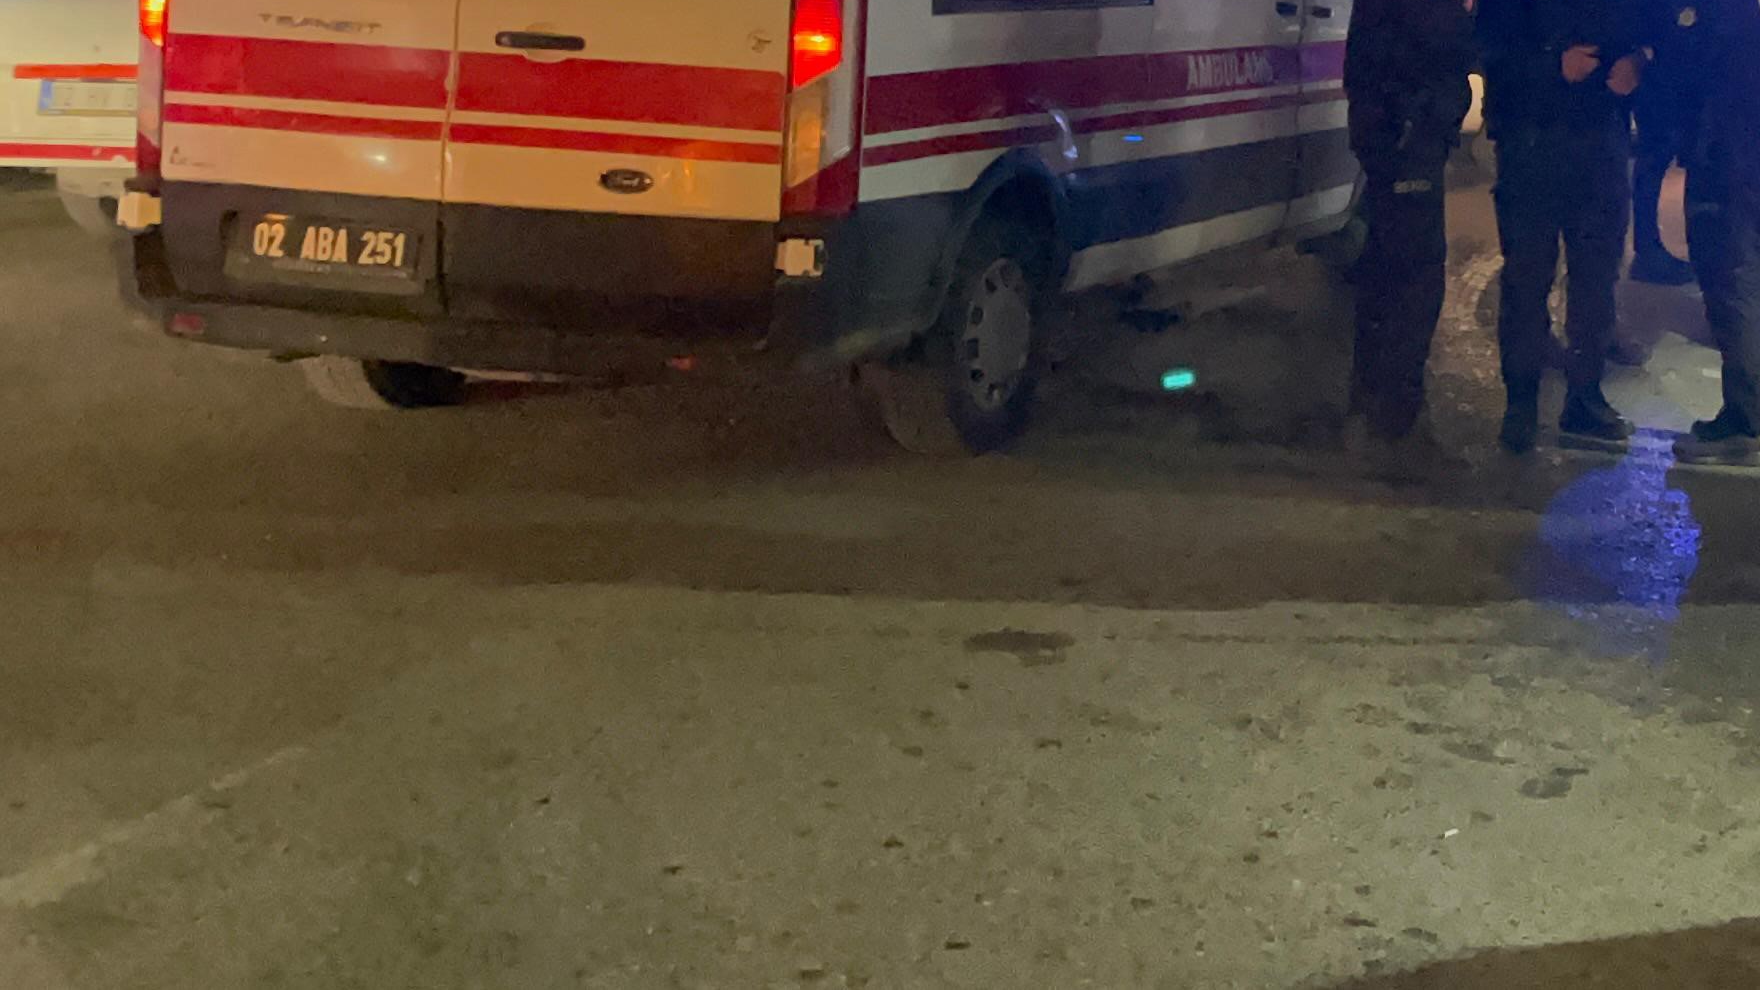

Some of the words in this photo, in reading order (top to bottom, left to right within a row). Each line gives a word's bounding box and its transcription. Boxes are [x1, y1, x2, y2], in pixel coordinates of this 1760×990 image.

[253, 222, 286, 258] 02
[300, 225, 349, 263] ABA
[358, 230, 406, 268] 251
